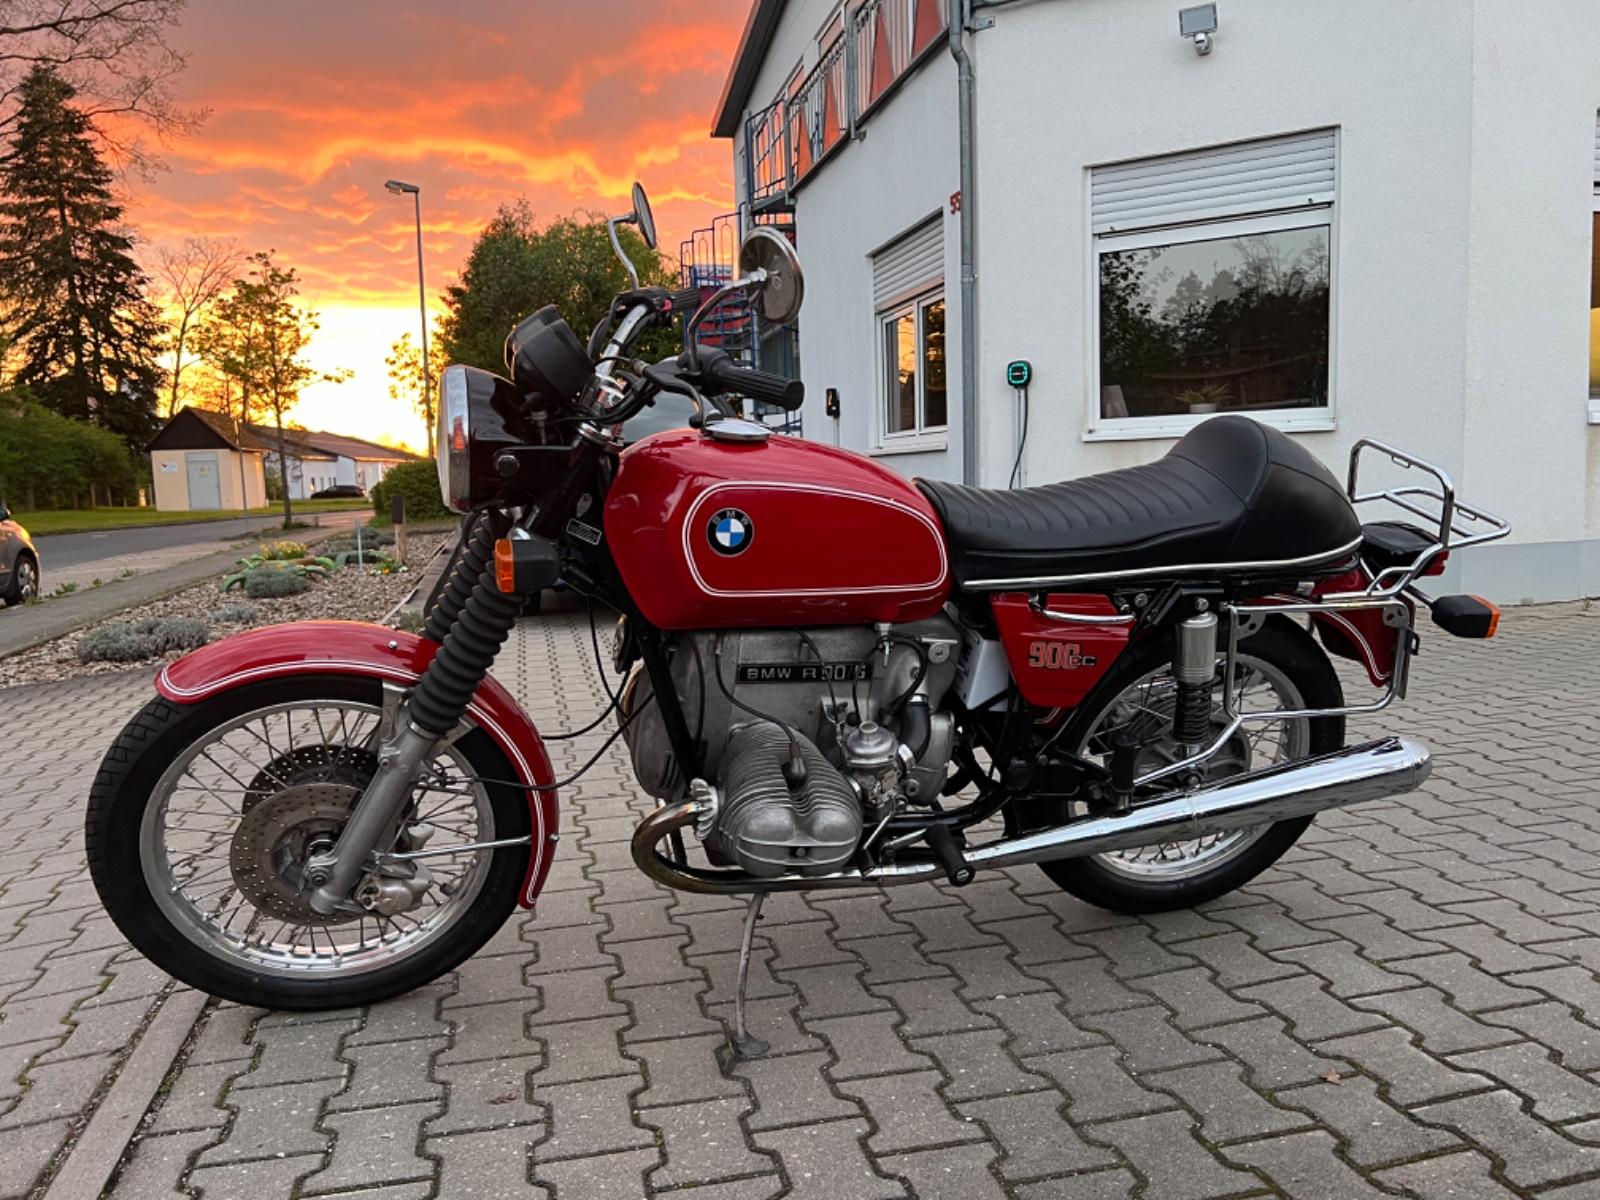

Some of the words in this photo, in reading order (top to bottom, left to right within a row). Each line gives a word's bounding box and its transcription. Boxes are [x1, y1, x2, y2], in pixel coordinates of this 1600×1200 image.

[712, 510, 749, 525] BMW
[746, 667, 792, 679] BMW
[802, 667, 817, 679] R
